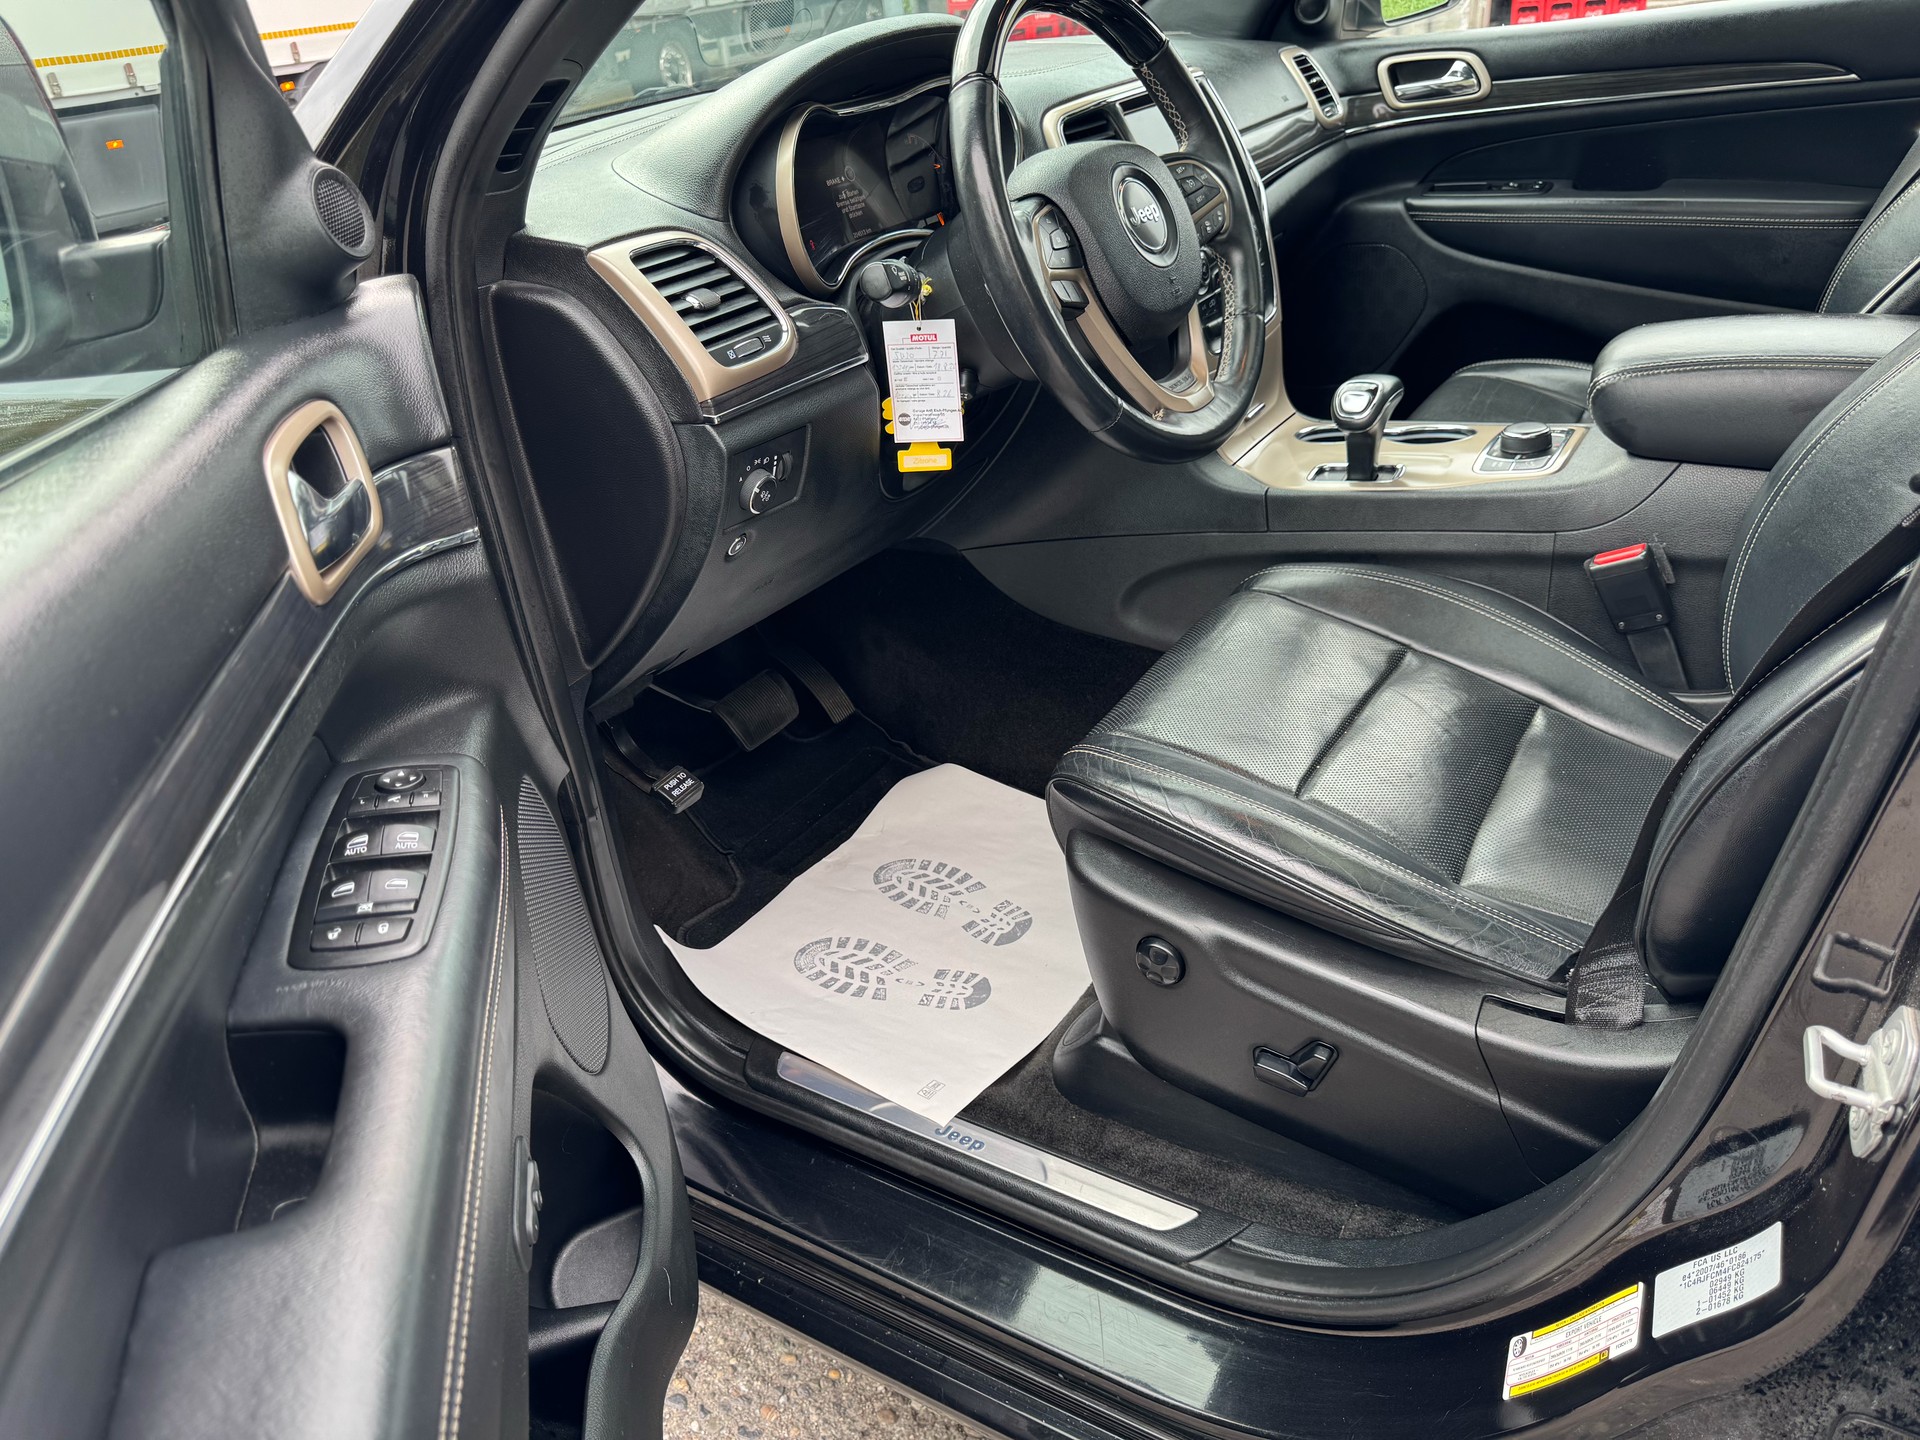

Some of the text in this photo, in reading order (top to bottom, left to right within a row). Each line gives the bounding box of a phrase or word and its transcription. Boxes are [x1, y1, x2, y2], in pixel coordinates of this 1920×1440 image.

[1129, 203, 1160, 227] Jeep
[911, 334, 937, 342] MOTUL
[663, 772, 687, 791] PUSH TO
[671, 778, 695, 797] RELEASE
[344, 846, 368, 856] AUTO
[395, 842, 418, 850] AUTO
[934, 1125, 986, 1151] Jeep
[1693, 1247, 1738, 1269] FCA US LLC
[1734, 1268, 1745, 1278] KG
[1734, 1277, 1744, 1287] KG
[1734, 1285, 1744, 1294] KG
[1733, 1292, 1744, 1302] KG
[1565, 1325, 1583, 1338] EXPORT
[1583, 1316, 1602, 1332] VEHICLE
